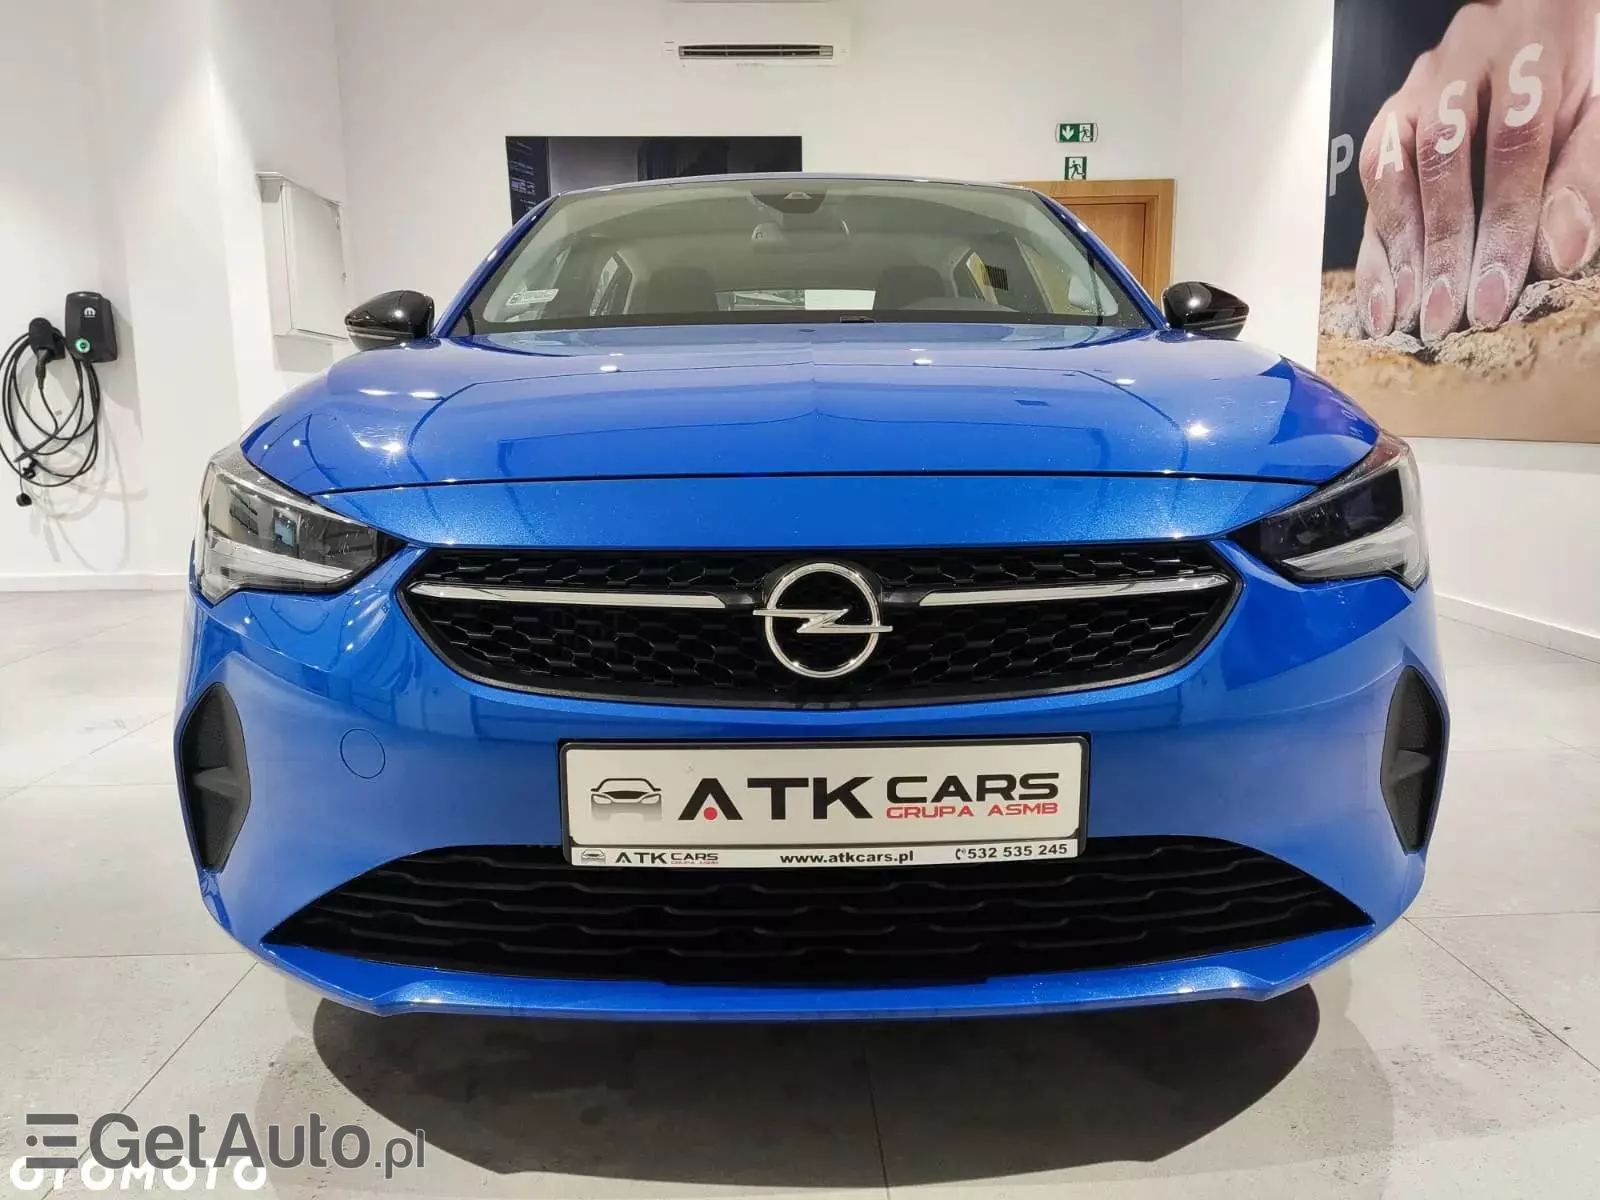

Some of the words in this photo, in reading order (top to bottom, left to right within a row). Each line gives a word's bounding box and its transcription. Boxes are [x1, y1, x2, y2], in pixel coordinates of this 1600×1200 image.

[678, 776, 874, 821] ATK
[886, 772, 1059, 804] CARS
[886, 804, 974, 819] GRUPA
[987, 802, 1058, 817] ASMB
[615, 852, 668, 864] ATK
[670, 852, 719, 861] CARS
[780, 850, 914, 864] www.atkcars.pl
[967, 847, 997, 859] 532
[1003, 845, 1032, 857] 535
[1038, 843, 1068, 855] 245
